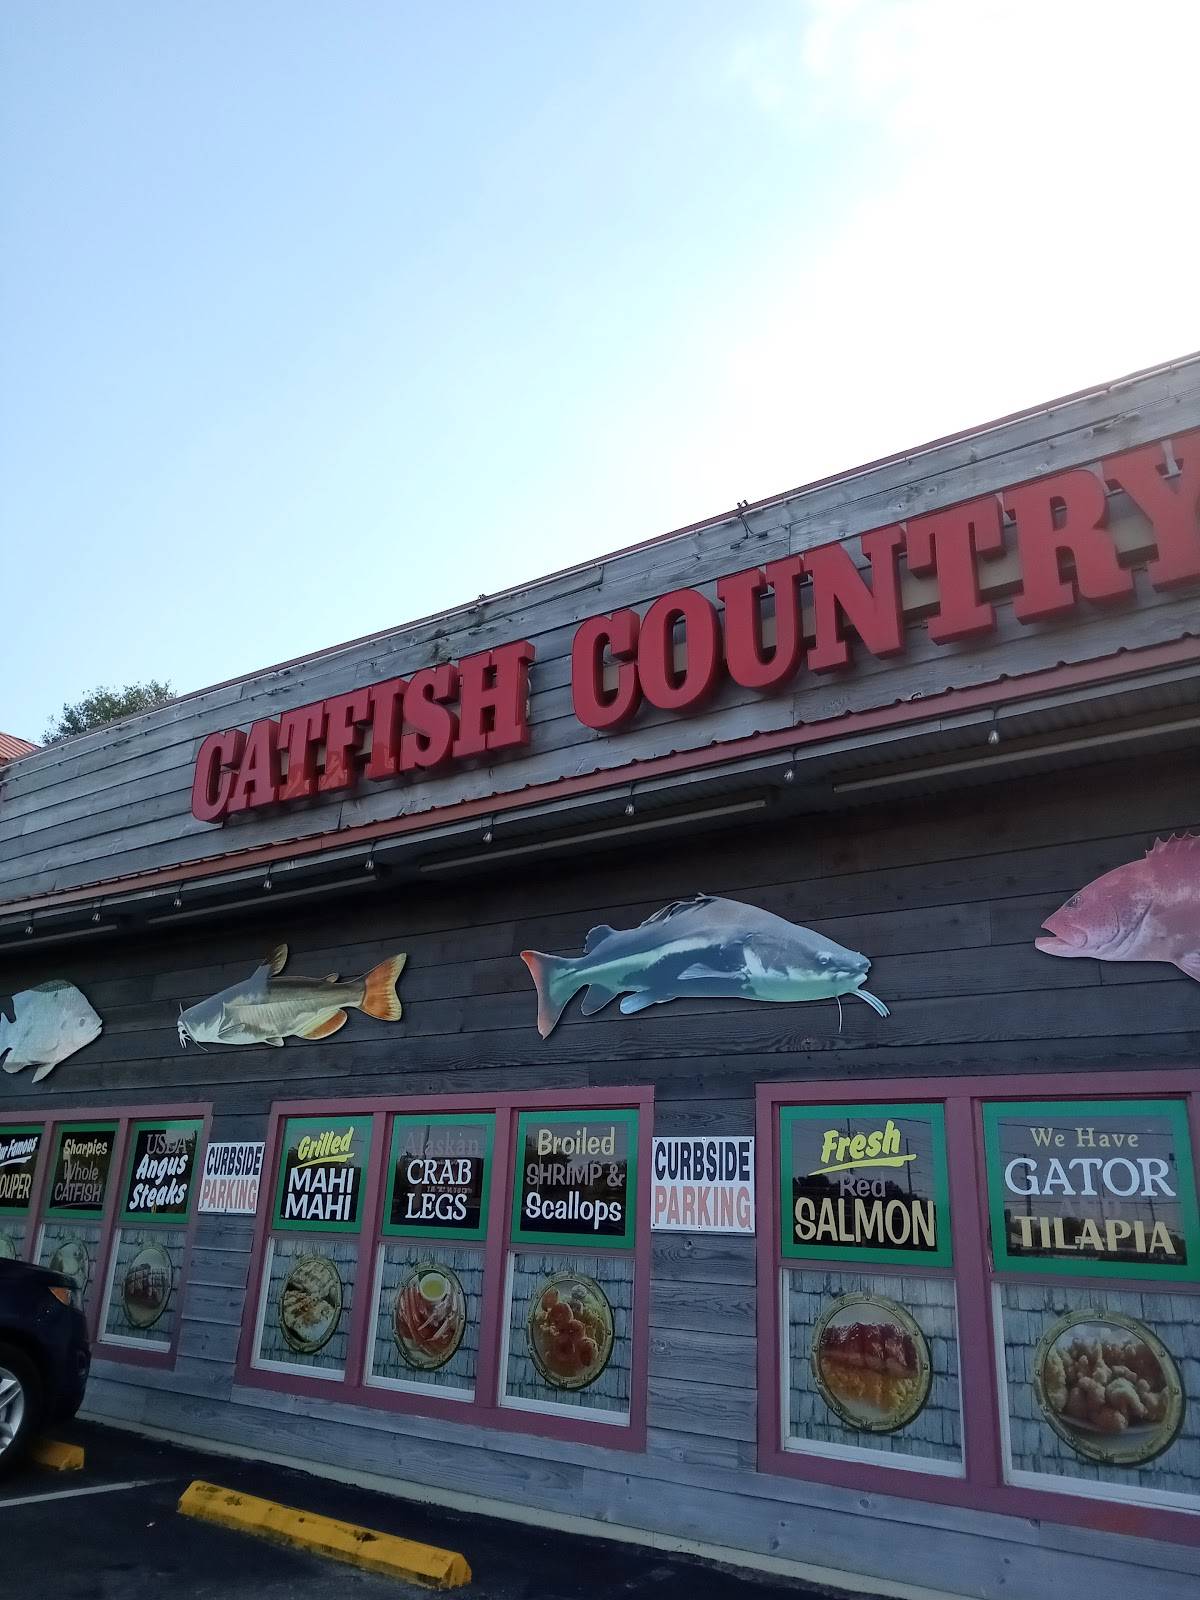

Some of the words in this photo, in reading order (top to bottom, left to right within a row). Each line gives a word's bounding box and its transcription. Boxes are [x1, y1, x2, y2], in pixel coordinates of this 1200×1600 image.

[190, 640, 535, 825] CATFISH
[572, 431, 1200, 732] COUNTRY
[7, 1136, 39, 1158] Famous
[64, 1138, 108, 1158] Sharpies
[297, 1126, 355, 1161] Grilled
[405, 1131, 480, 1156] Alaskan
[537, 1126, 616, 1157] Broiled
[820, 1119, 902, 1164] Fresh
[1030, 1127, 1065, 1148] We
[1076, 1127, 1139, 1148] Have
[63, 1160, 99, 1181] Whole
[136, 1153, 189, 1185] Angus
[206, 1145, 263, 1176] CURBSIDE
[407, 1159, 472, 1185] CRAB
[526, 1163, 602, 1187] SHRIMP
[606, 1165, 625, 1187] &
[654, 1141, 751, 1182] CURBSIDE
[54, 1182, 102, 1202] CATFISH
[288, 1167, 354, 1193] MAHI
[839, 1173, 887, 1198] Red
[1004, 1157, 1177, 1197] GATOR
[129, 1178, 188, 1210] Steaks
[202, 1179, 257, 1210] PARKING
[284, 1194, 352, 1221] MAHI
[405, 1193, 468, 1220] LEGS
[654, 1184, 752, 1229] PARKING
[526, 1191, 622, 1229] Scallops
[794, 1197, 937, 1248] SALMON
[1014, 1216, 1177, 1255] TILAPIA
